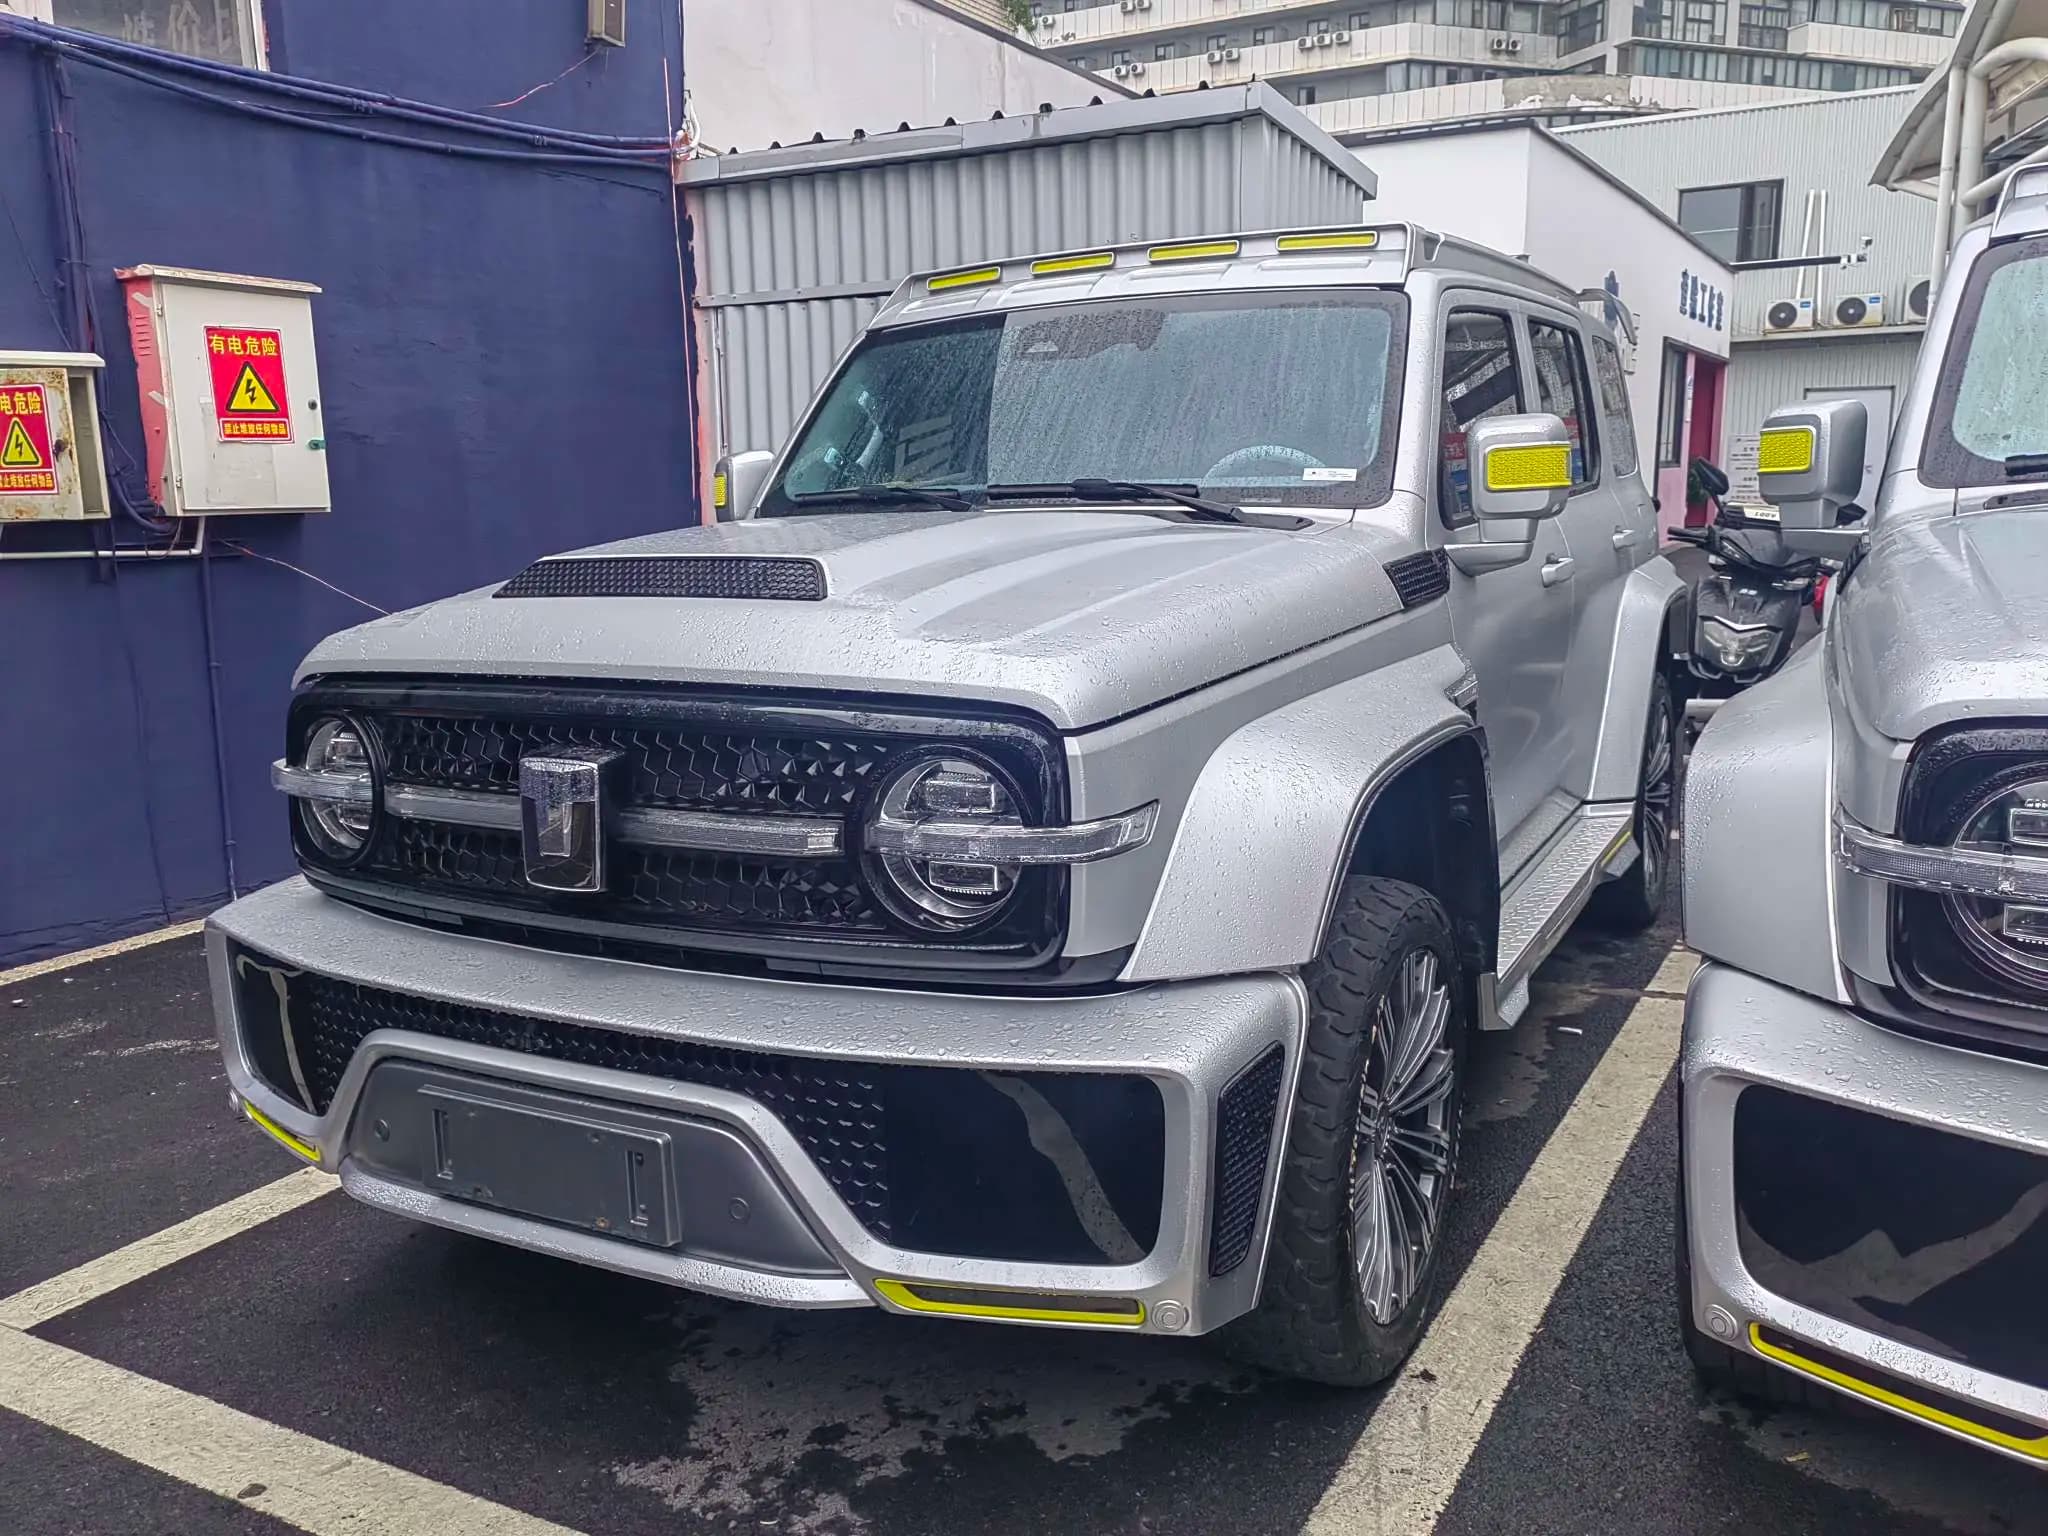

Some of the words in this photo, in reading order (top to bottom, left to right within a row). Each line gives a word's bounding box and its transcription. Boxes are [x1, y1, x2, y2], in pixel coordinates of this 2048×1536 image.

[208, 334, 278, 356] 有电危险
[223, 423, 288, 435] 禁止堆放任何物品
